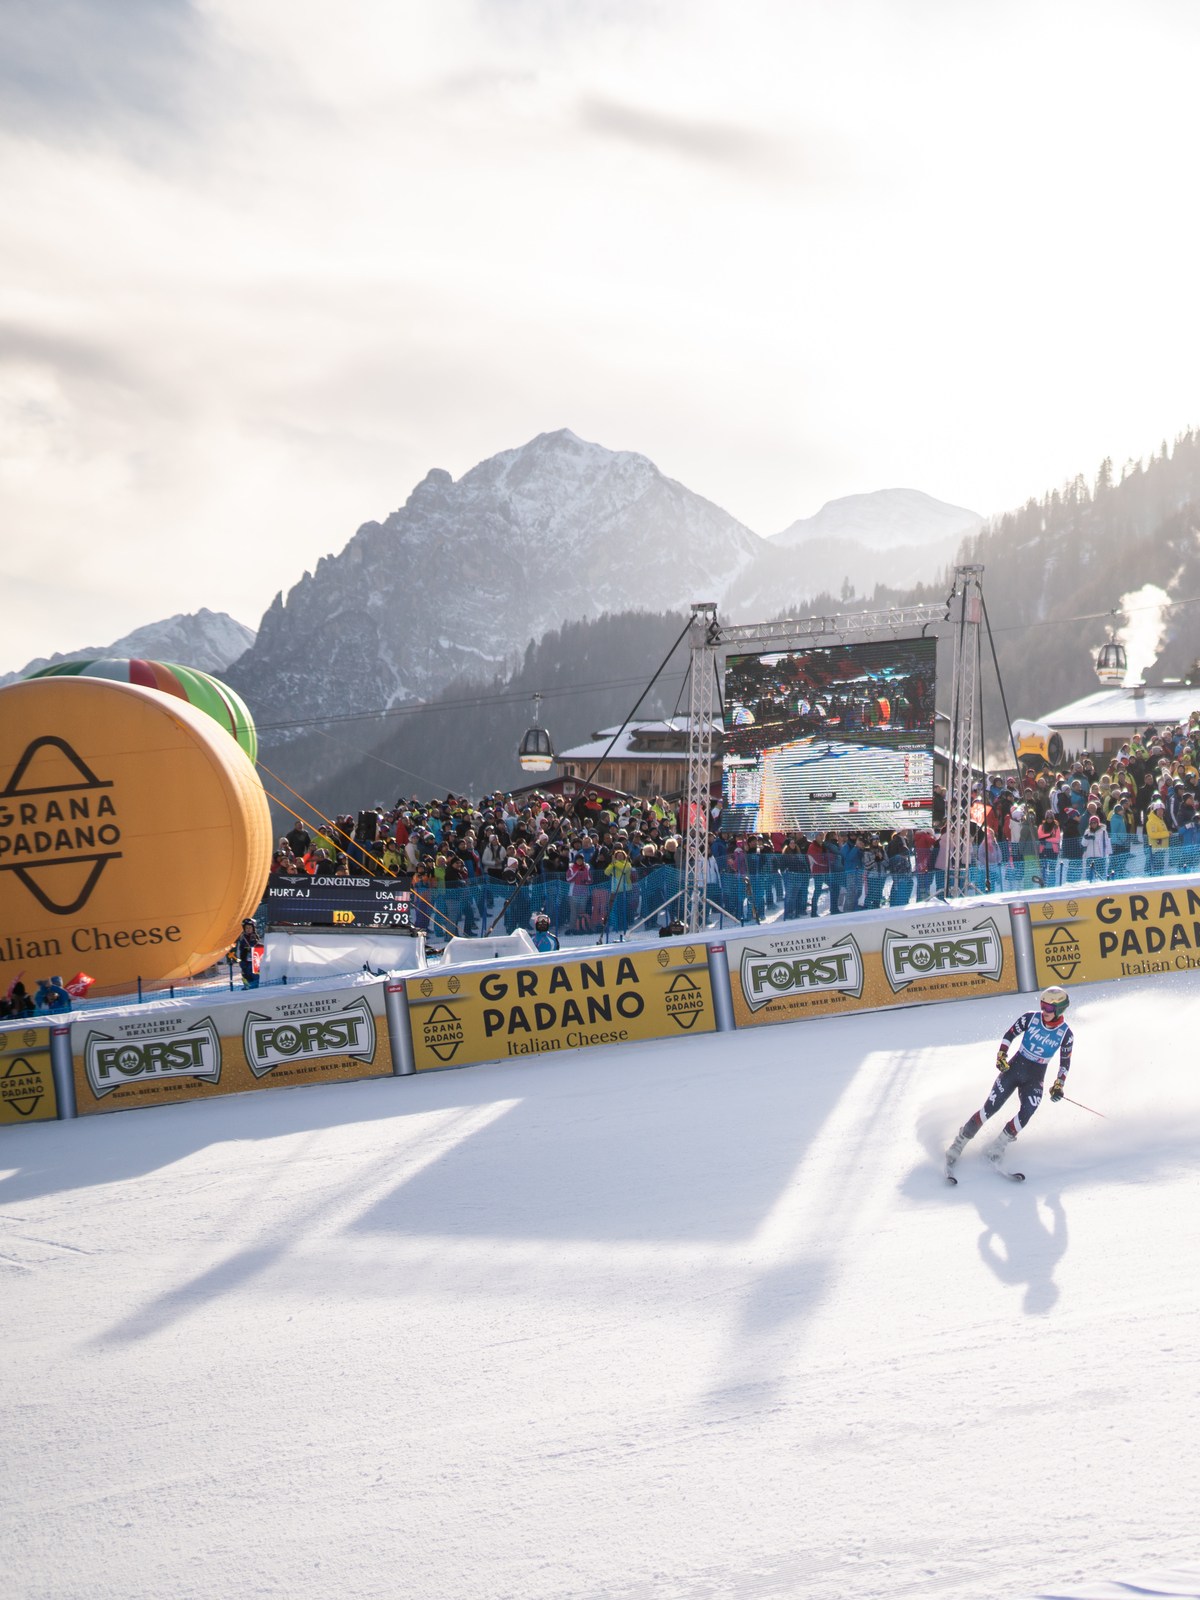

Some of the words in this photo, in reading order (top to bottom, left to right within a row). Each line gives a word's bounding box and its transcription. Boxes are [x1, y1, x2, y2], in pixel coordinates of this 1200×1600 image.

[0, 795, 116, 827] GRANA
[311, 877, 370, 887] LONGINES
[270, 888, 295, 897] HURT
[296, 889, 303, 897] A
[305, 889, 310, 898] J
[376, 891, 394, 900] USA
[383, 903, 409, 911] +1.89
[336, 912, 350, 922] 10
[373, 913, 409, 924] 57.93
[911, 918, 970, 931] SPEZIALBIER-
[918, 925, 962, 935] BRAUEREI
[0, 938, 61, 961] lian
[71, 925, 182, 952] Cheese
[770, 935, 830, 948] SPEZIALBIER-
[777, 942, 822, 953] BRAUEREI
[893, 936, 992, 973] FORST
[1045, 944, 1080, 954] GRANA
[1045, 951, 1082, 963] PADANO
[751, 953, 852, 993] FORST
[1120, 960, 1170, 976] Italian
[479, 957, 640, 1001] GRANA
[665, 992, 702, 1004] GRANA
[275, 998, 340, 1011] SPEZIALBIER-
[283, 1005, 331, 1016] BRAUEREI
[665, 1000, 704, 1012] PADANO
[482, 990, 645, 1038] PADANO
[119, 1018, 185, 1031] SPEZIALBIER-
[423, 1023, 463, 1034] GRANA
[126, 1026, 176, 1036] BRAUEREI
[1028, 1026, 1059, 1047] Marlene
[255, 1016, 364, 1059] FORST
[424, 1031, 465, 1044] PADANO
[507, 1037, 561, 1056] Italian
[566, 1028, 629, 1049] Cheese
[1030, 1043, 1045, 1056] 12
[96, 1037, 209, 1078] FORST
[0, 1077, 42, 1088] GRANA
[2, 1086, 44, 1097] PADANO
